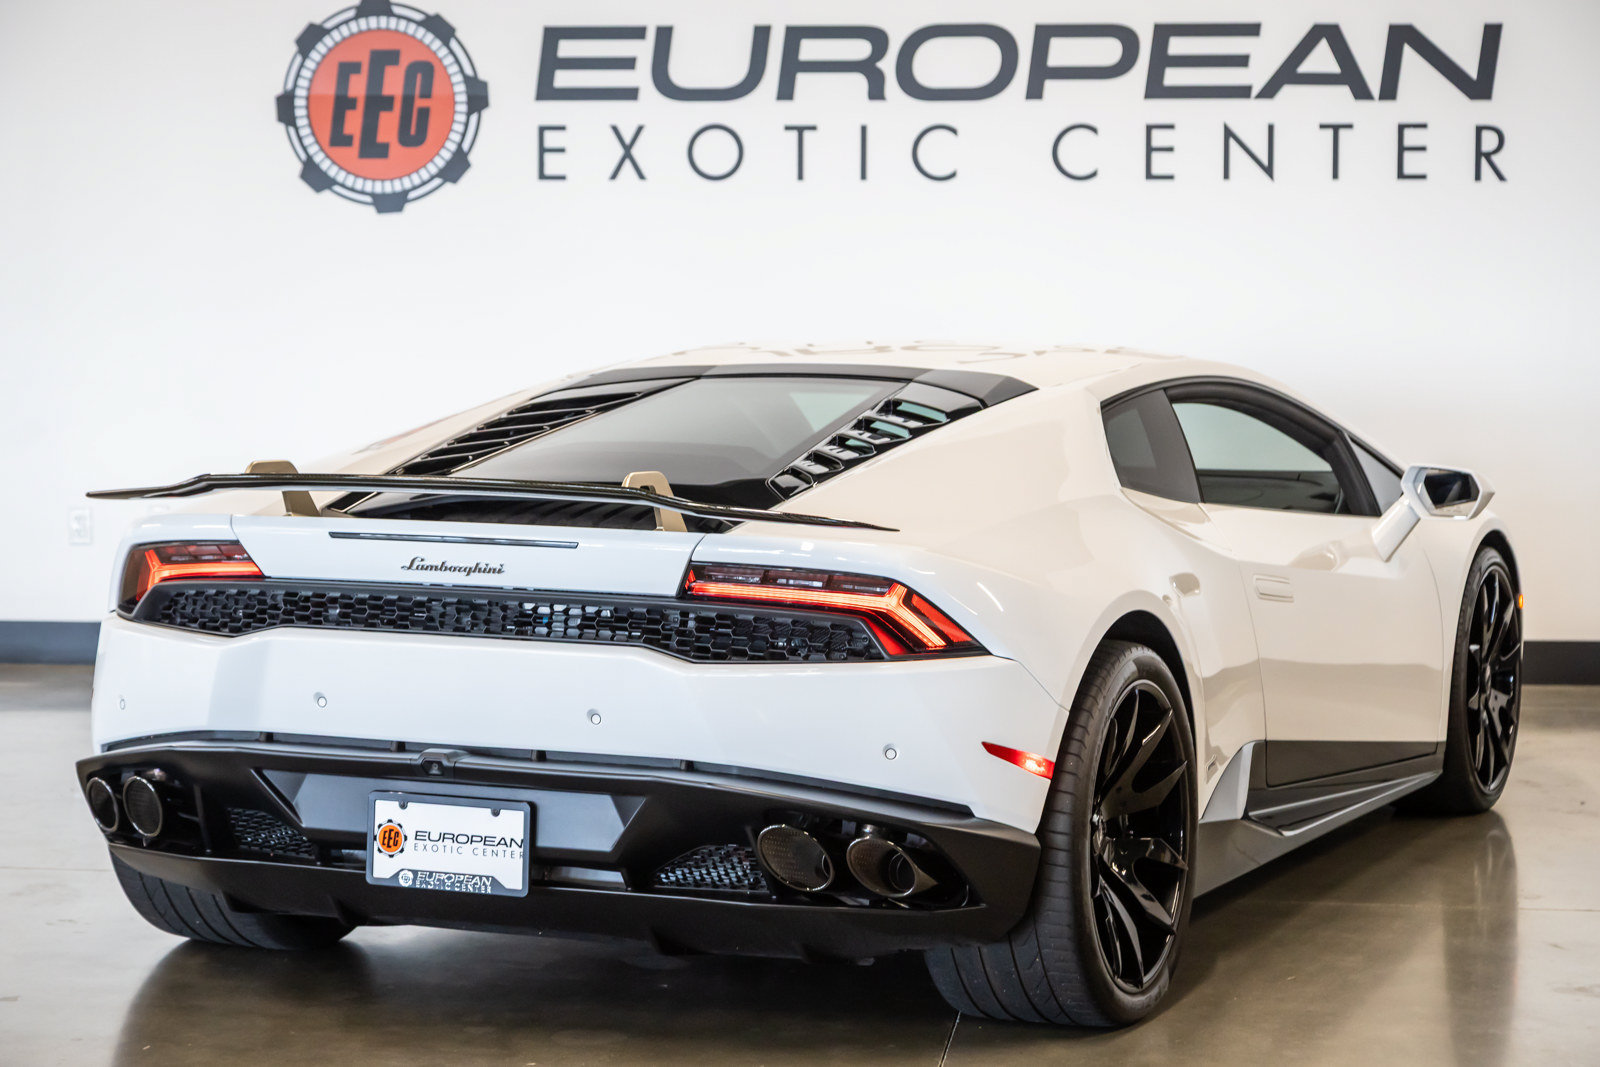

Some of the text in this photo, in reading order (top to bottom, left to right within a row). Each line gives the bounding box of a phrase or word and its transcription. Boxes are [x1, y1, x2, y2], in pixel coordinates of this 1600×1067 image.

[536, 23, 1503, 101] EUROPEAN
[329, 49, 435, 159] EEC
[538, 123, 1507, 182] EXOTIC CENTER
[401, 556, 505, 576] Lamborghini
[382, 828, 400, 848] EEC
[414, 830, 524, 849] EUROPEAN
[413, 843, 524, 859] EXOTIC CENTER
[417, 871, 492, 886] EUROPEAN
